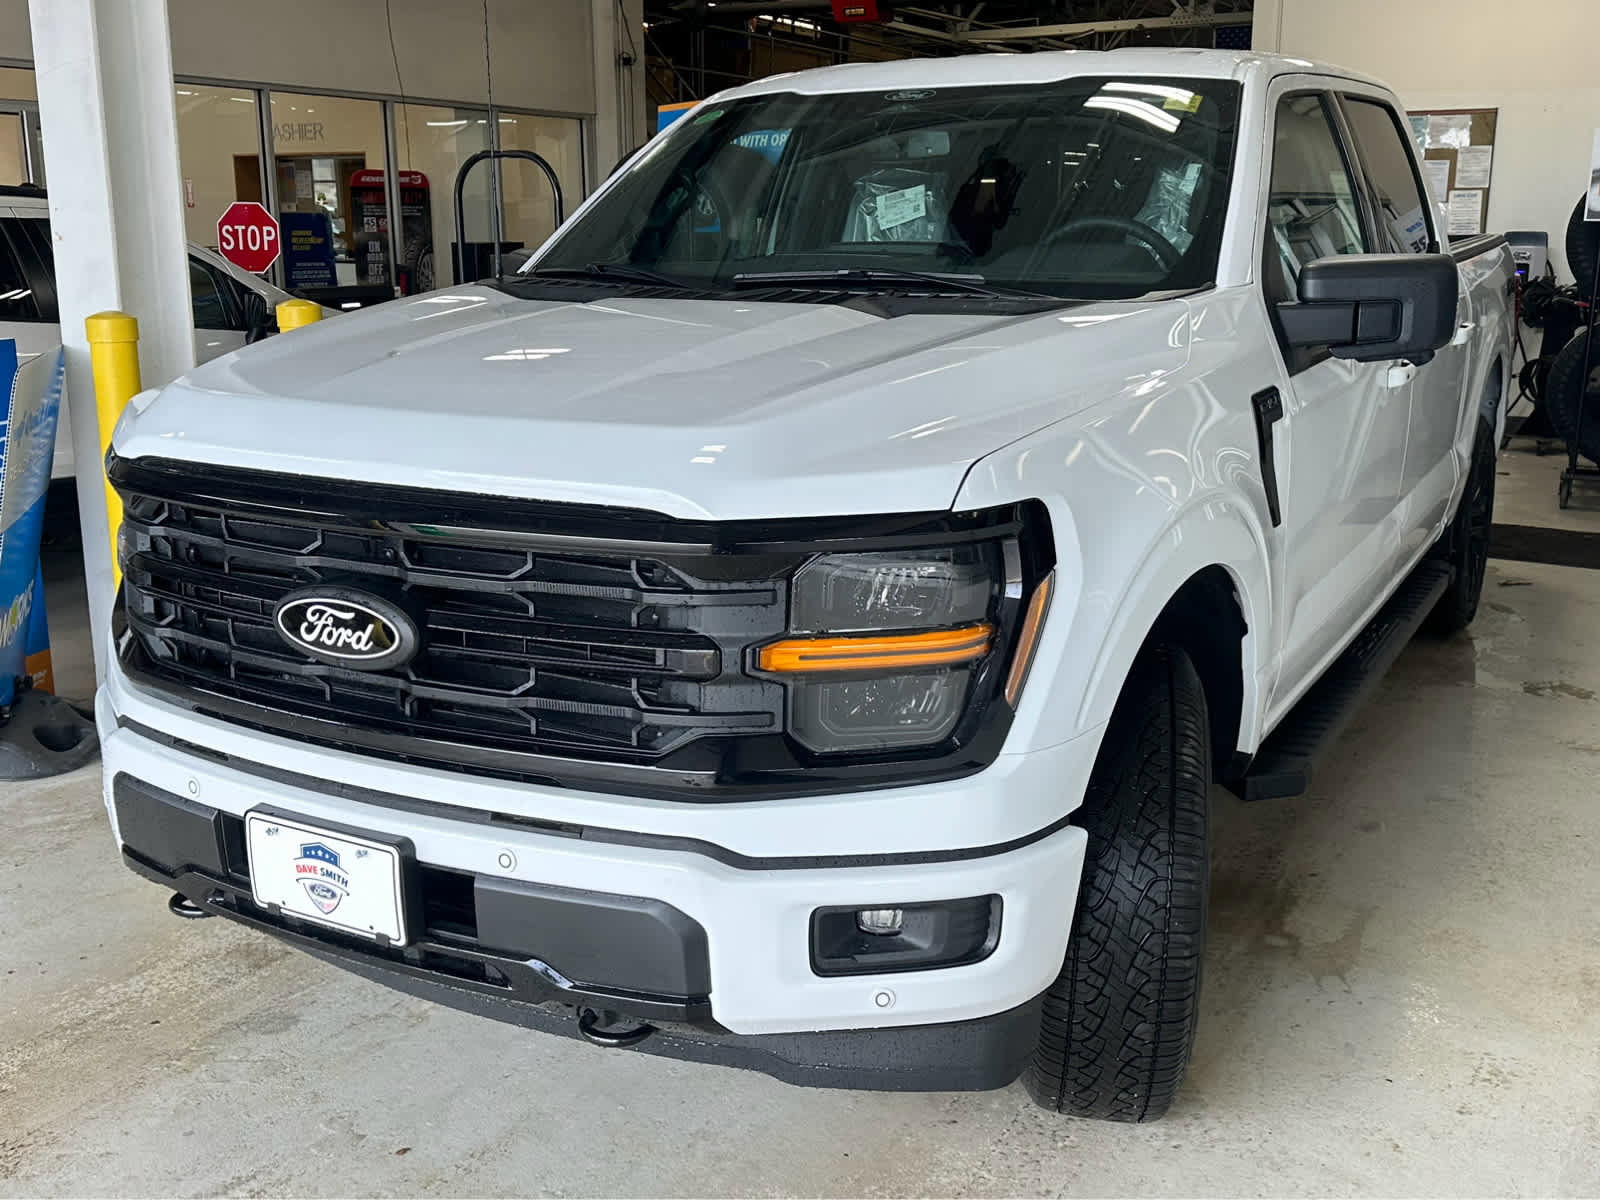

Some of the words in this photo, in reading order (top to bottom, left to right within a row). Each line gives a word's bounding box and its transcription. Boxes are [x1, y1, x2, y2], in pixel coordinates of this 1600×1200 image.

[740, 134, 769, 149] WITH
[221, 225, 276, 251] STOP
[300, 604, 375, 651] Ford
[296, 864, 318, 875] DAVE
[320, 867, 349, 888] SMITH
